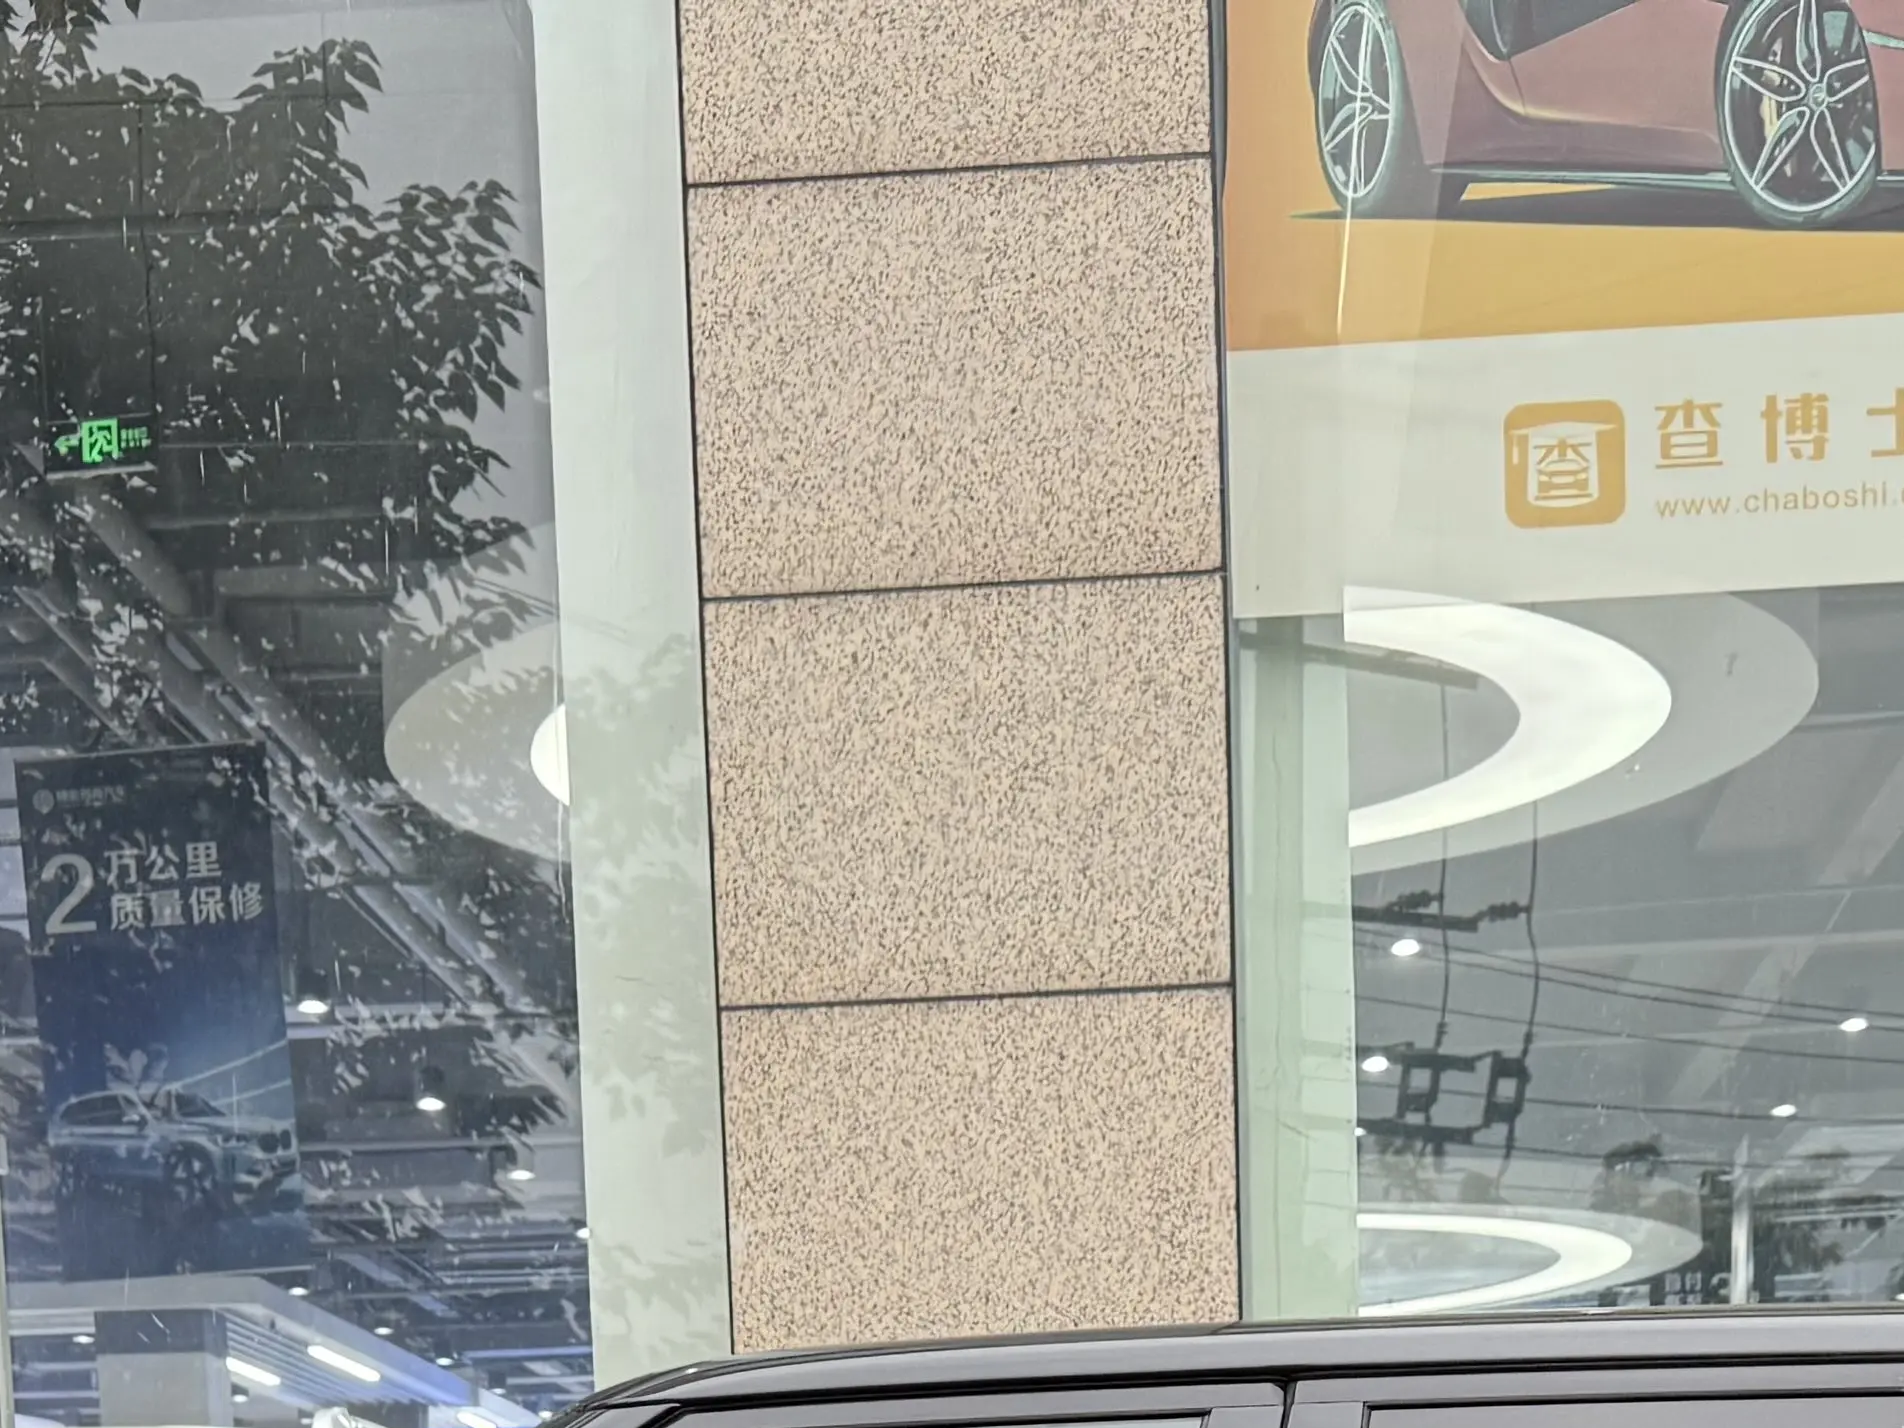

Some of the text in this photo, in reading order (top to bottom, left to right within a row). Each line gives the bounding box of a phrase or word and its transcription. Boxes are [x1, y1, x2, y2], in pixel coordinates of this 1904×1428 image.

[103, 840, 223, 887] 万公里
[109, 881, 264, 932] 质量保修
